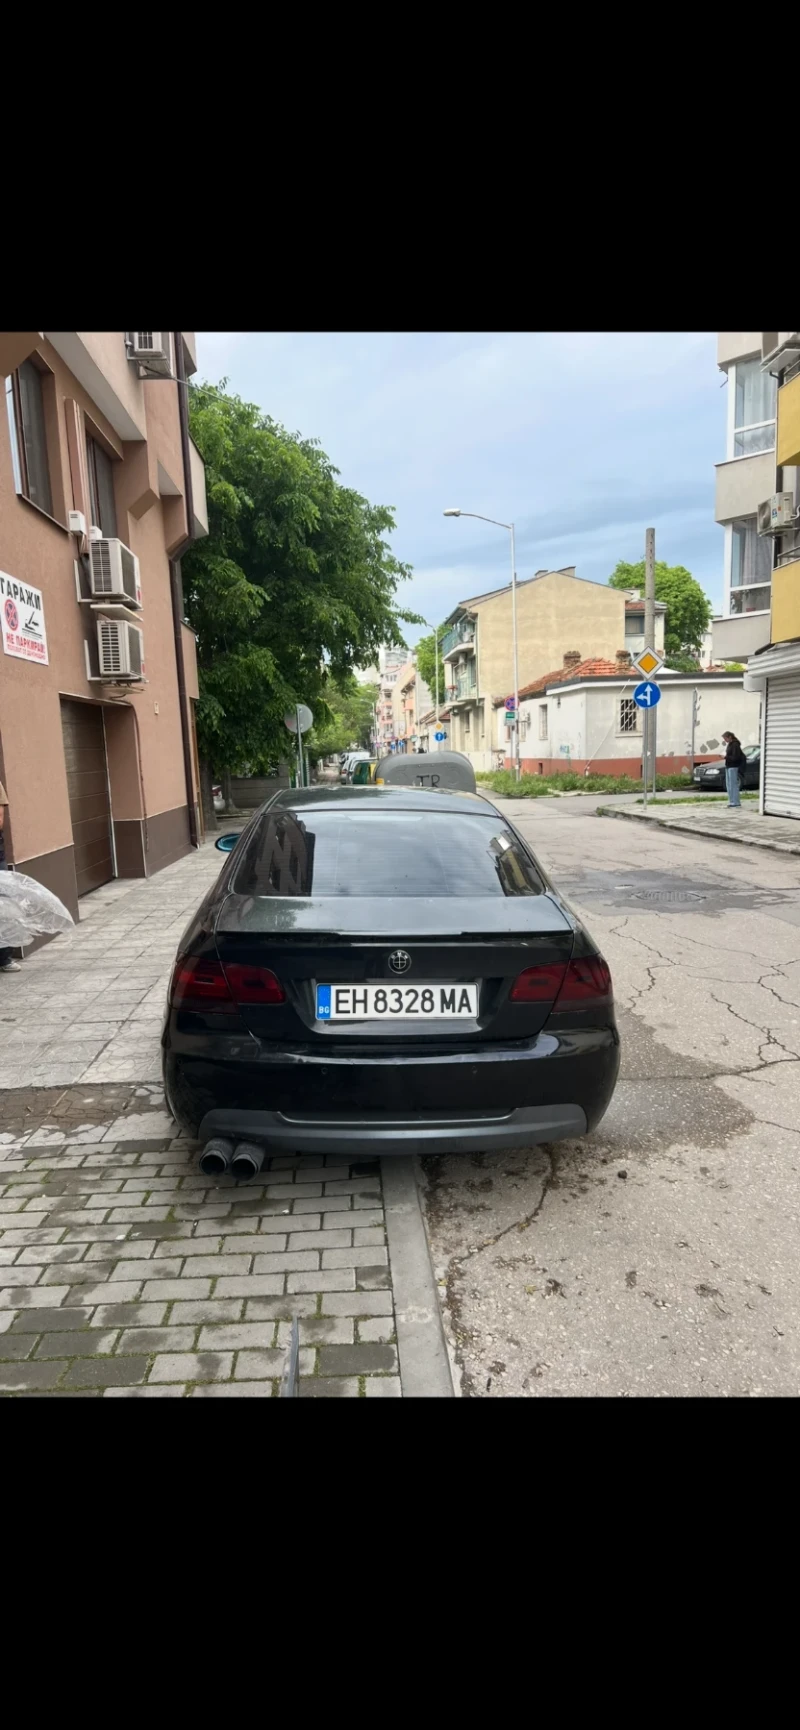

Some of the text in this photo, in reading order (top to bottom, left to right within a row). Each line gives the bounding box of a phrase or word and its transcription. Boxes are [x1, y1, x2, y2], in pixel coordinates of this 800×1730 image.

[335, 988, 472, 1014] EH 8328 MA
[318, 1006, 329, 1014] BG
